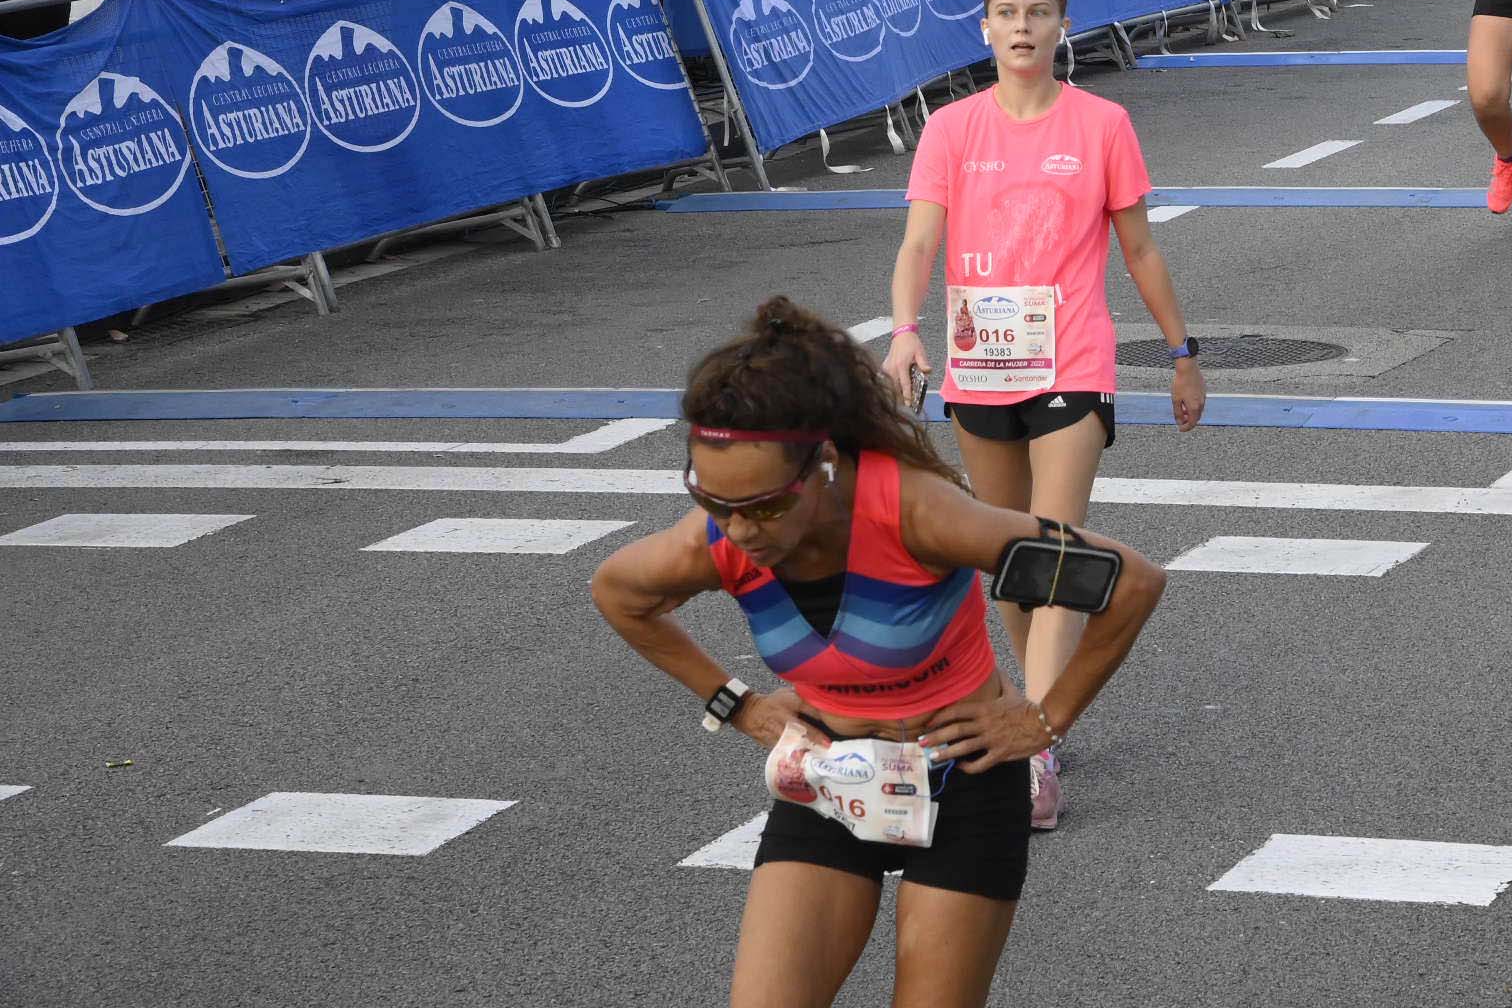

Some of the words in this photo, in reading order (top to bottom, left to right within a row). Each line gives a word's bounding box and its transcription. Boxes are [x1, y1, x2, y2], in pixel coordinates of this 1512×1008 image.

[427, 52, 520, 101] ASTURIANA
[523, 37, 609, 83] ASTURIANA
[316, 75, 416, 126] ASTURIANA
[200, 98, 306, 152] ASTURIANA
[960, 252, 994, 277] TU
[979, 328, 1015, 343] 016
[984, 348, 1012, 357] 19383
[1013, 374, 1048, 382] Santander
